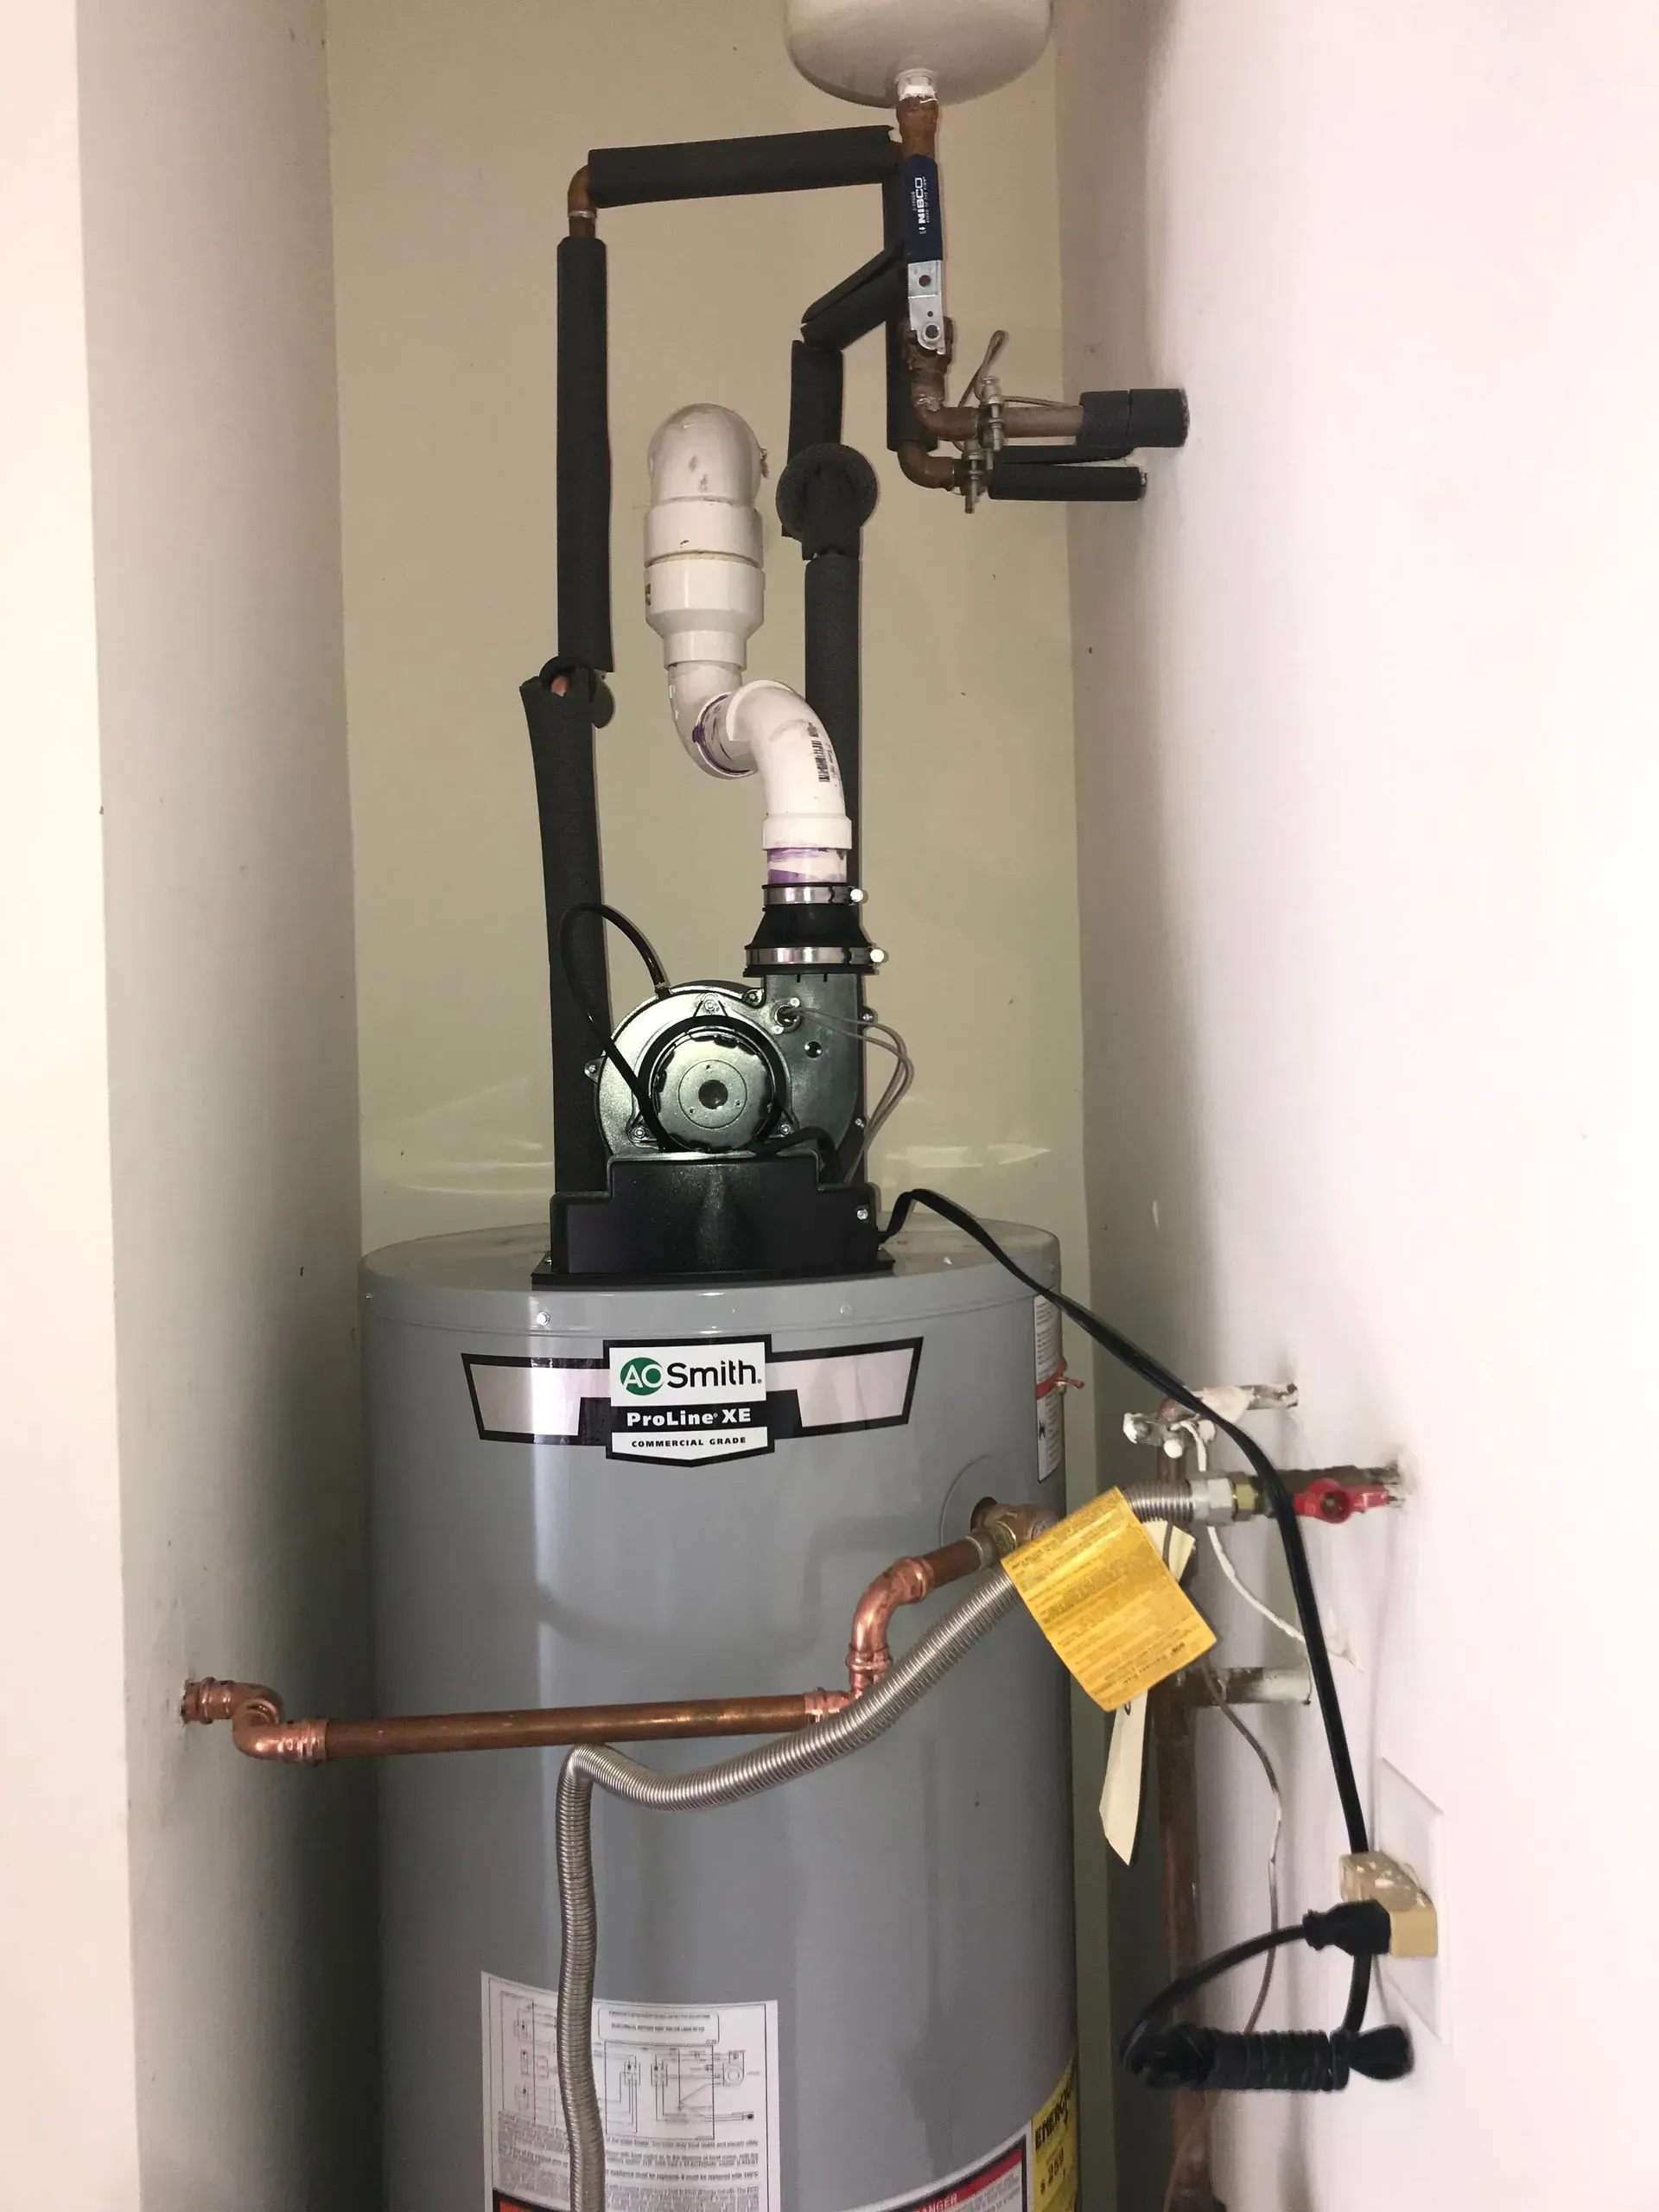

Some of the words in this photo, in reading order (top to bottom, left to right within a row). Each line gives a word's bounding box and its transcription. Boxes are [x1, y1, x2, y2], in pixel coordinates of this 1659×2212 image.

[915, 177, 925, 224] NIBCO
[721, 1408, 751, 1424] XE
[632, 1439, 704, 1447] COMMERCIAL
[709, 1436, 747, 1445] GRADE
